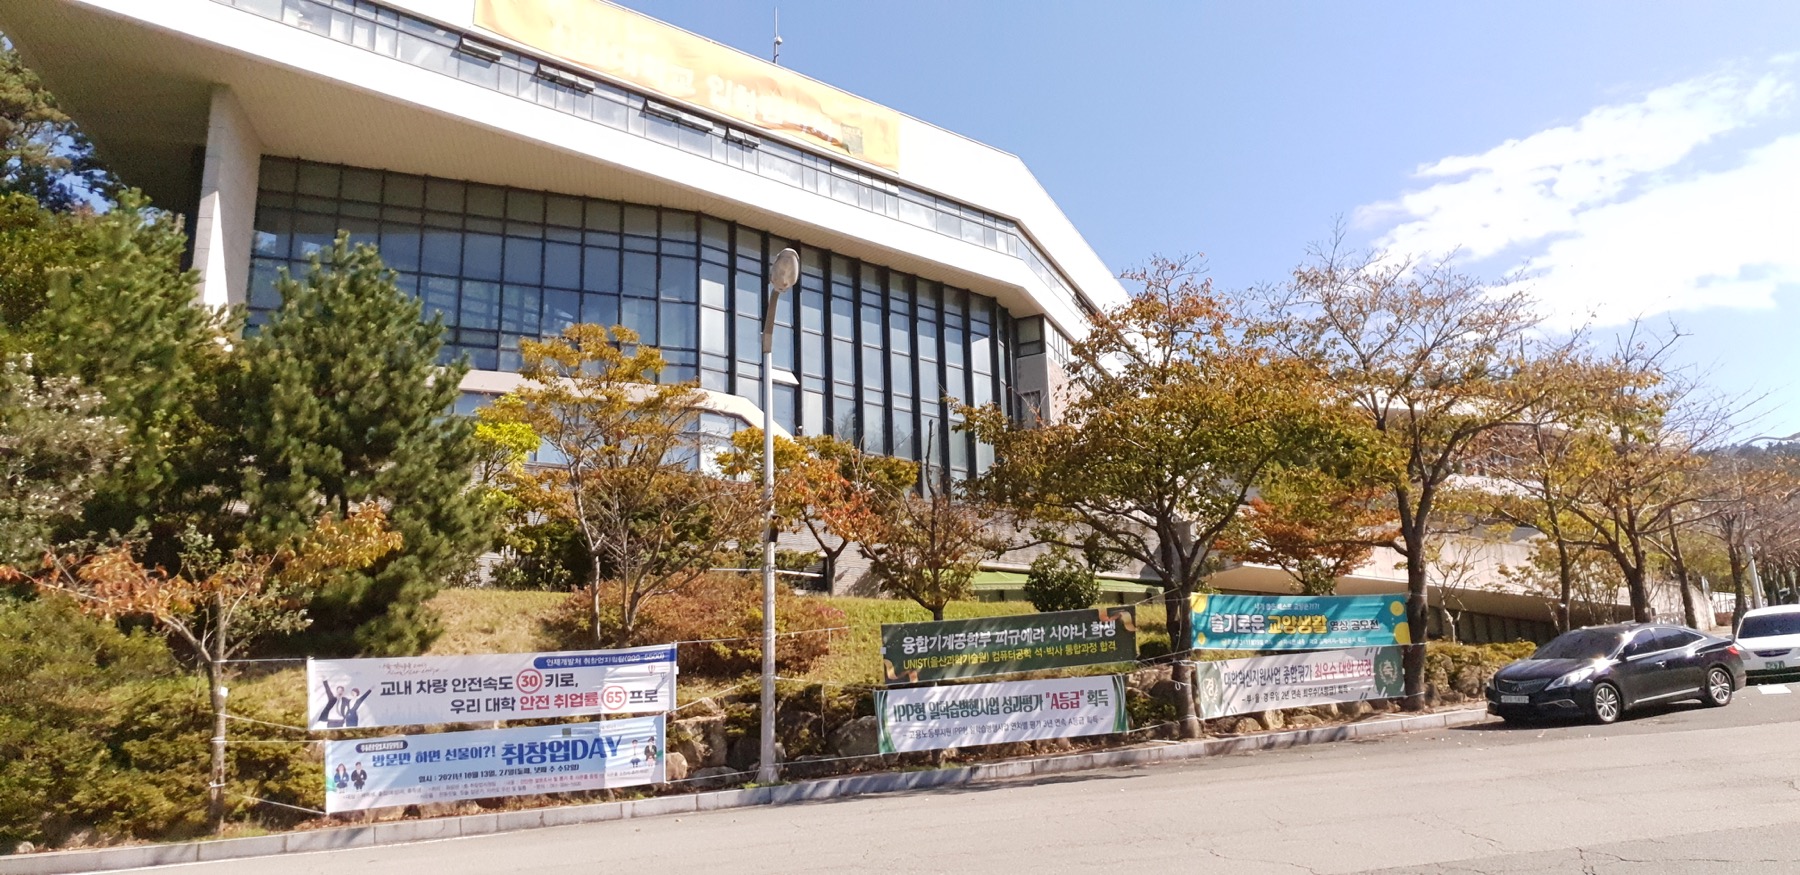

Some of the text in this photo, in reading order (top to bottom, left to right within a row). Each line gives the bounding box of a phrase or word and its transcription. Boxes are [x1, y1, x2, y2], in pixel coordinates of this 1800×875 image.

[902, 619, 1116, 655] 융합기계공학부 피규에라 시야나 학생
[1210, 613, 1379, 635] 슬기로운 교양생활 영상 공모전
[903, 640, 1117, 670] UNIST(울산과학기술원) 컴퓨터공학 석·박사 통합과정 합격
[380, 672, 579, 696] 교내 차량 안전속도 30 키로,
[1223, 666, 1281, 688] 대학혁신지원사업
[1283, 664, 1312, 685] 종합평가
[1314, 661, 1338, 679] 최우수
[450, 689, 659, 714] 우리 대학 안전 취업률 65 프로
[893, 701, 927, 722] IPP형
[928, 696, 1000, 720] 일학습병행사업
[1001, 693, 1044, 715] 성과평가
[1087, 688, 1109, 707] 획득
[372, 735, 623, 768] 방문만 하면 선물이?! 취창업DAY
